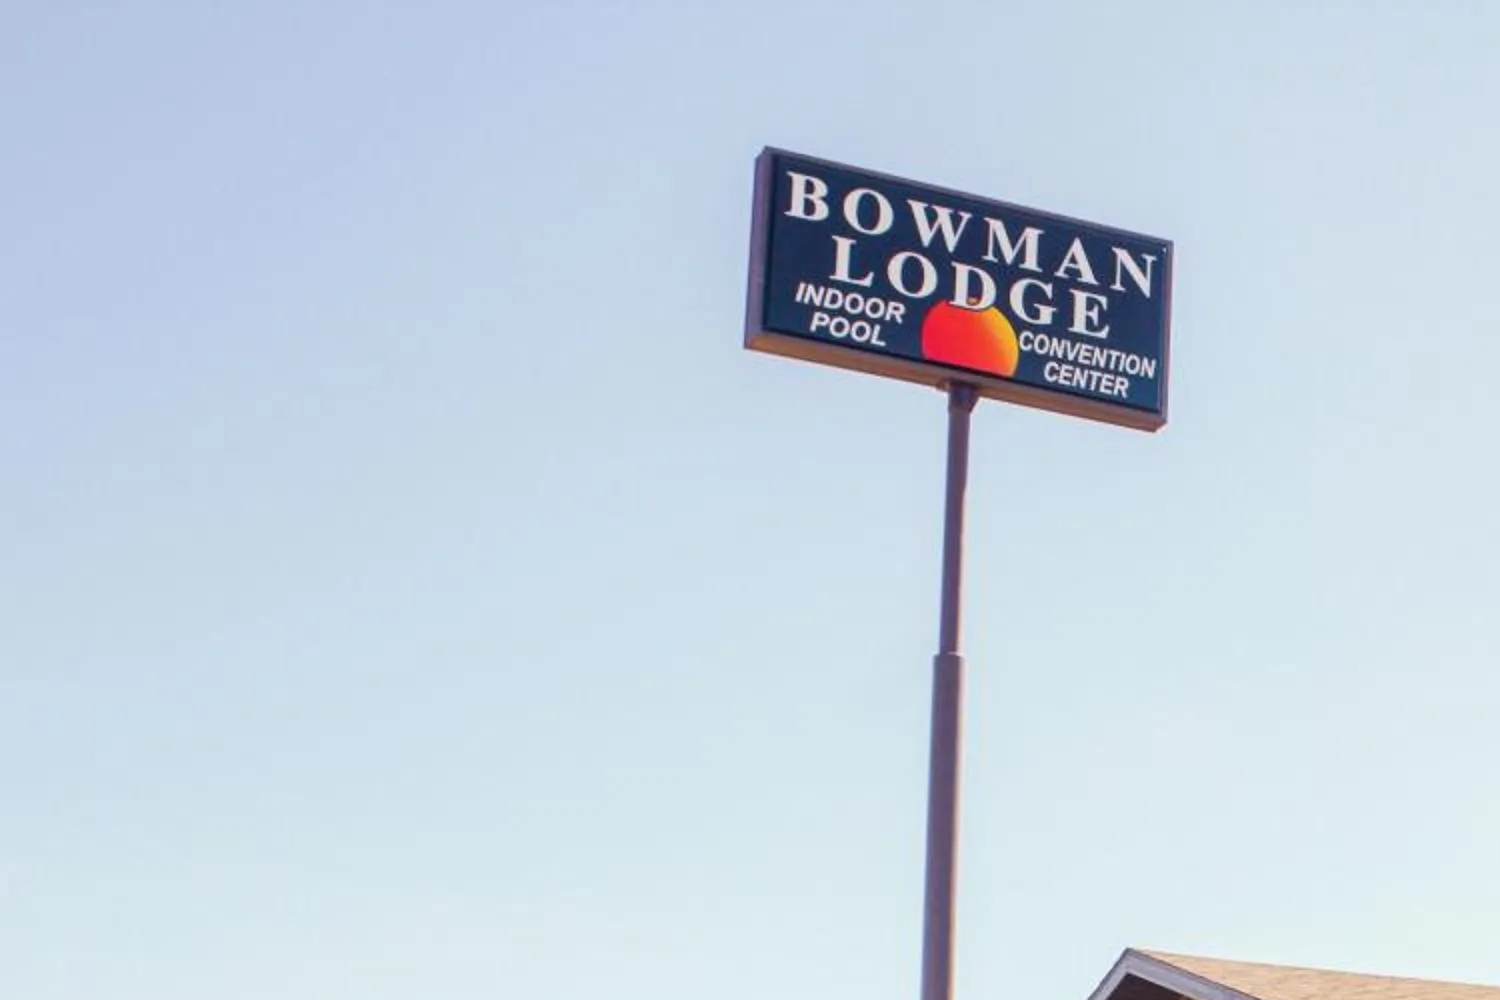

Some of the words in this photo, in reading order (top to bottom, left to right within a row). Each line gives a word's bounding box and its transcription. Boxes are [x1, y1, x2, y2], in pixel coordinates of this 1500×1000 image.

[784, 170, 1157, 299] BOWMAN
[795, 281, 906, 324] INDOOR
[829, 234, 1110, 339] LODGE
[810, 311, 886, 346] POOL
[1019, 330, 1156, 379] CONVENTION
[1044, 360, 1129, 398] CENTER
